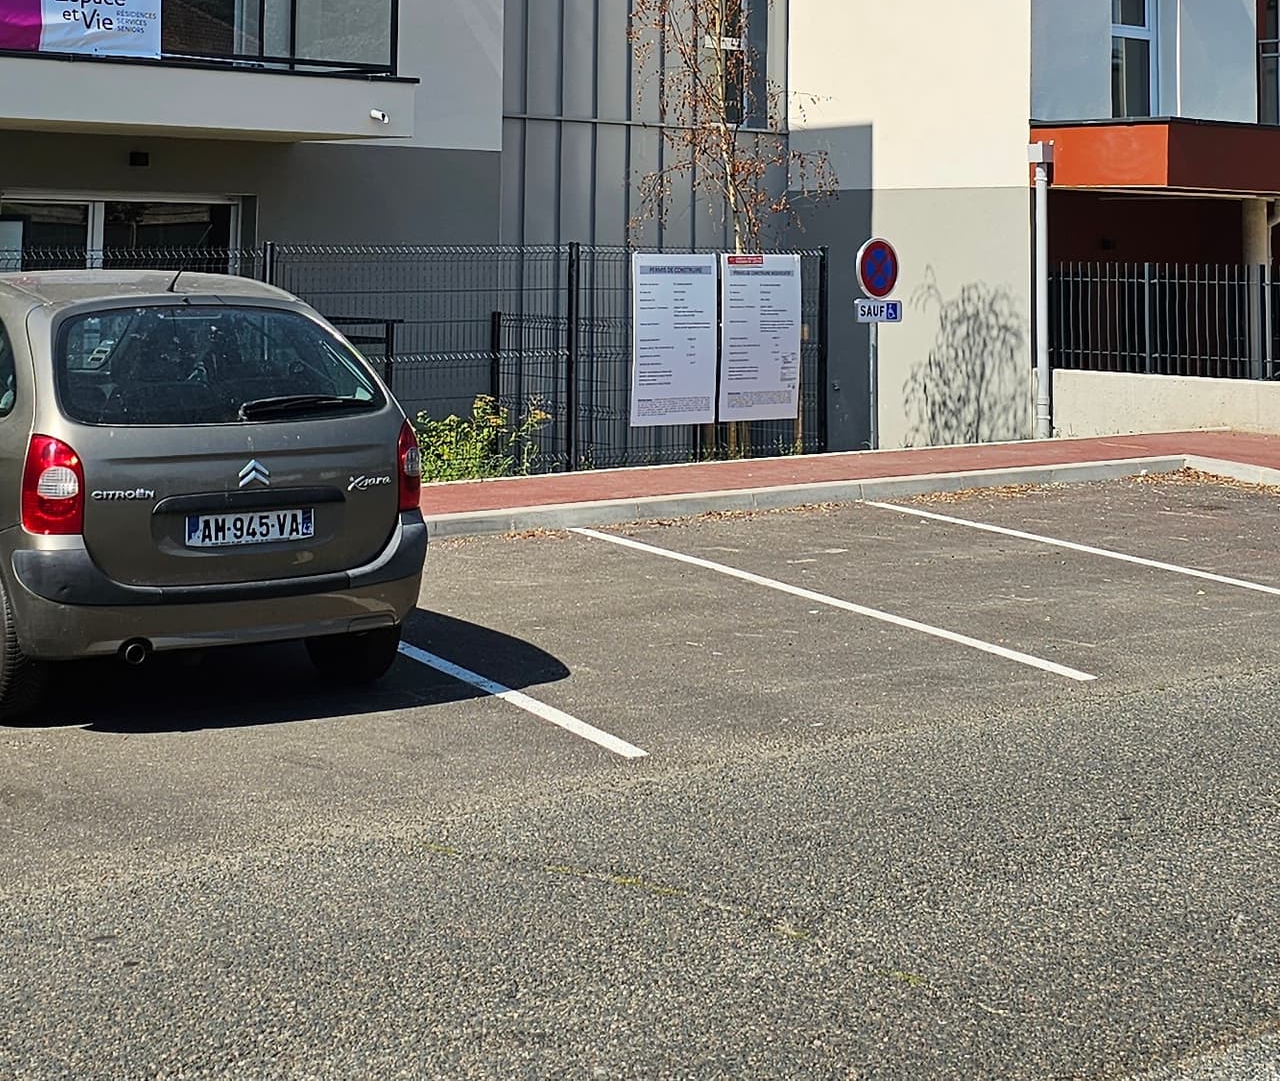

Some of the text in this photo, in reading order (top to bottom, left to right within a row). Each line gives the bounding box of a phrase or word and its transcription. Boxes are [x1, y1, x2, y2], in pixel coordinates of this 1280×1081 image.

[62, 8, 114, 31] et Vie
[116, 18, 148, 27] SERVICES
[116, 25, 145, 34] SENIORS
[860, 305, 885, 317] SAUF
[347, 475, 391, 491] Xsara
[91, 488, 155, 500] CITROËN
[201, 513, 300, 543] AM-945-VA
